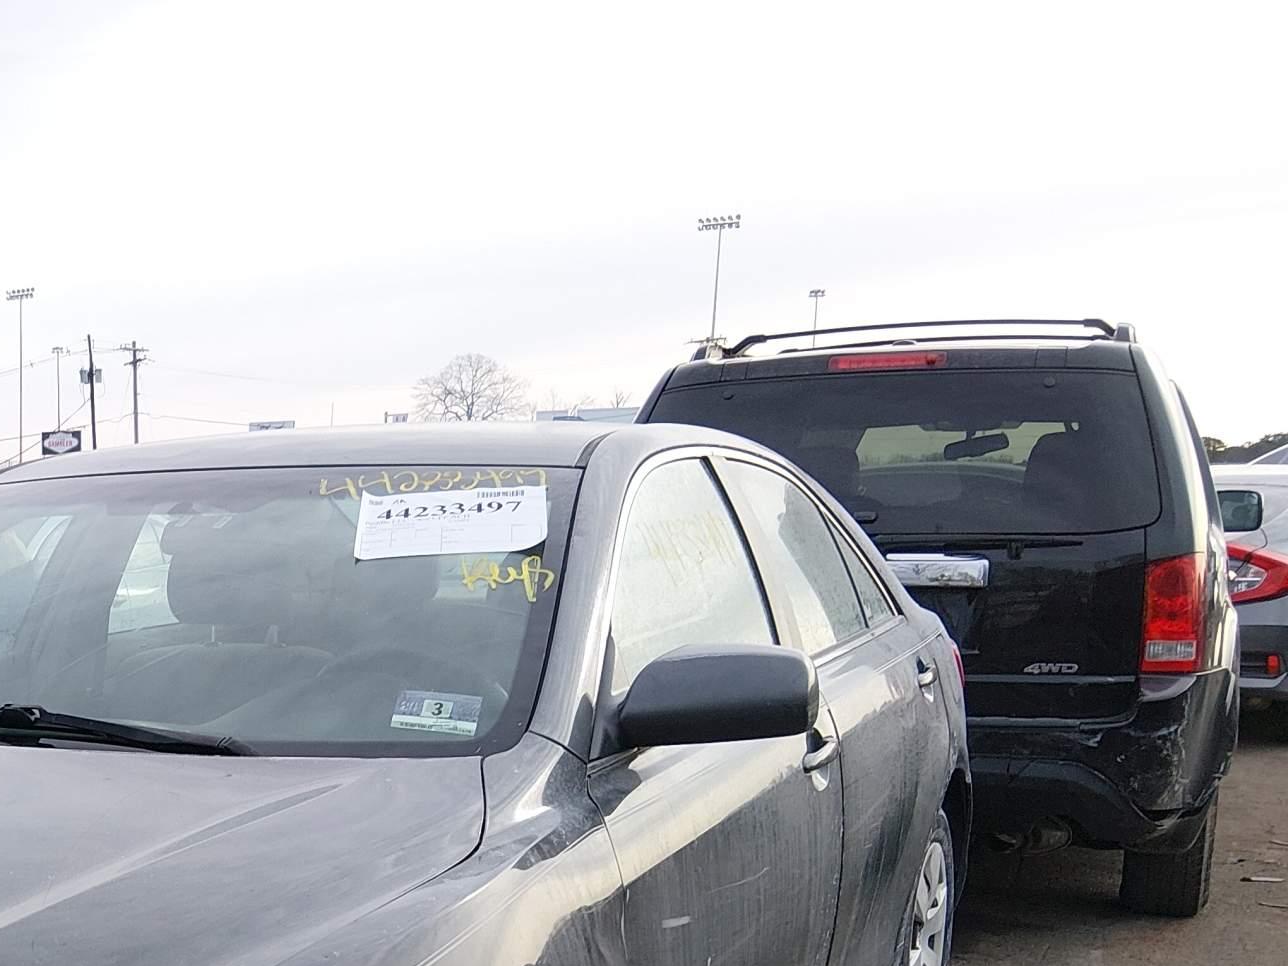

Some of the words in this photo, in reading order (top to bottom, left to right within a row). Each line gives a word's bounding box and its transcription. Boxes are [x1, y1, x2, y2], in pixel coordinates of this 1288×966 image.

[377, 500, 523, 520] 44233497
[1023, 663, 1079, 674] 4WD
[431, 702, 444, 716] 3
